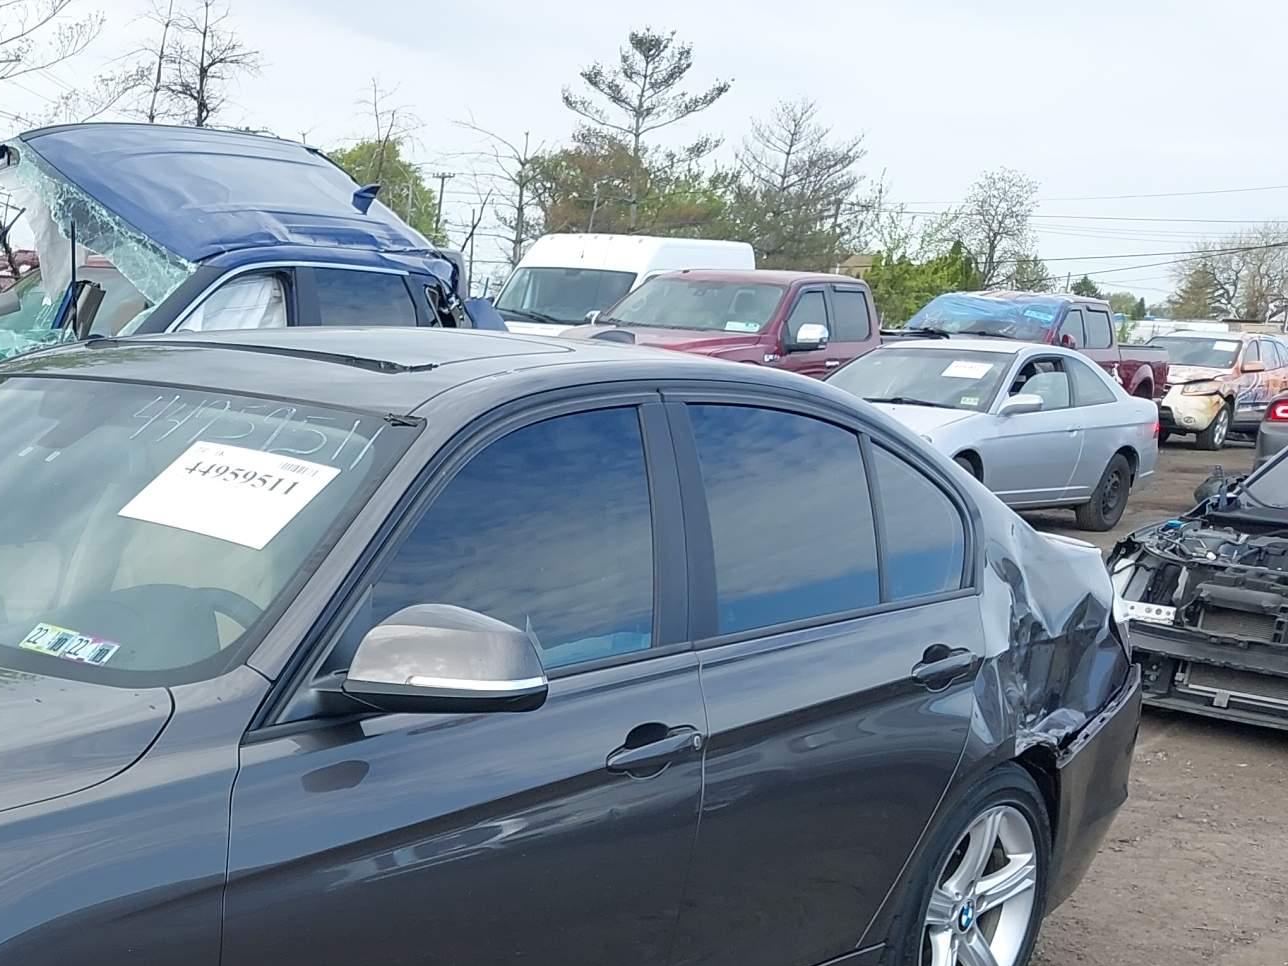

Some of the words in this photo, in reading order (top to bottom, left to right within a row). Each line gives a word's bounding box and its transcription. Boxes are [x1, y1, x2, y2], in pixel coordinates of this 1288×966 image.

[185, 460, 300, 495] 44959511
[26, 626, 49, 645] 22
[66, 637, 90, 656] 22
